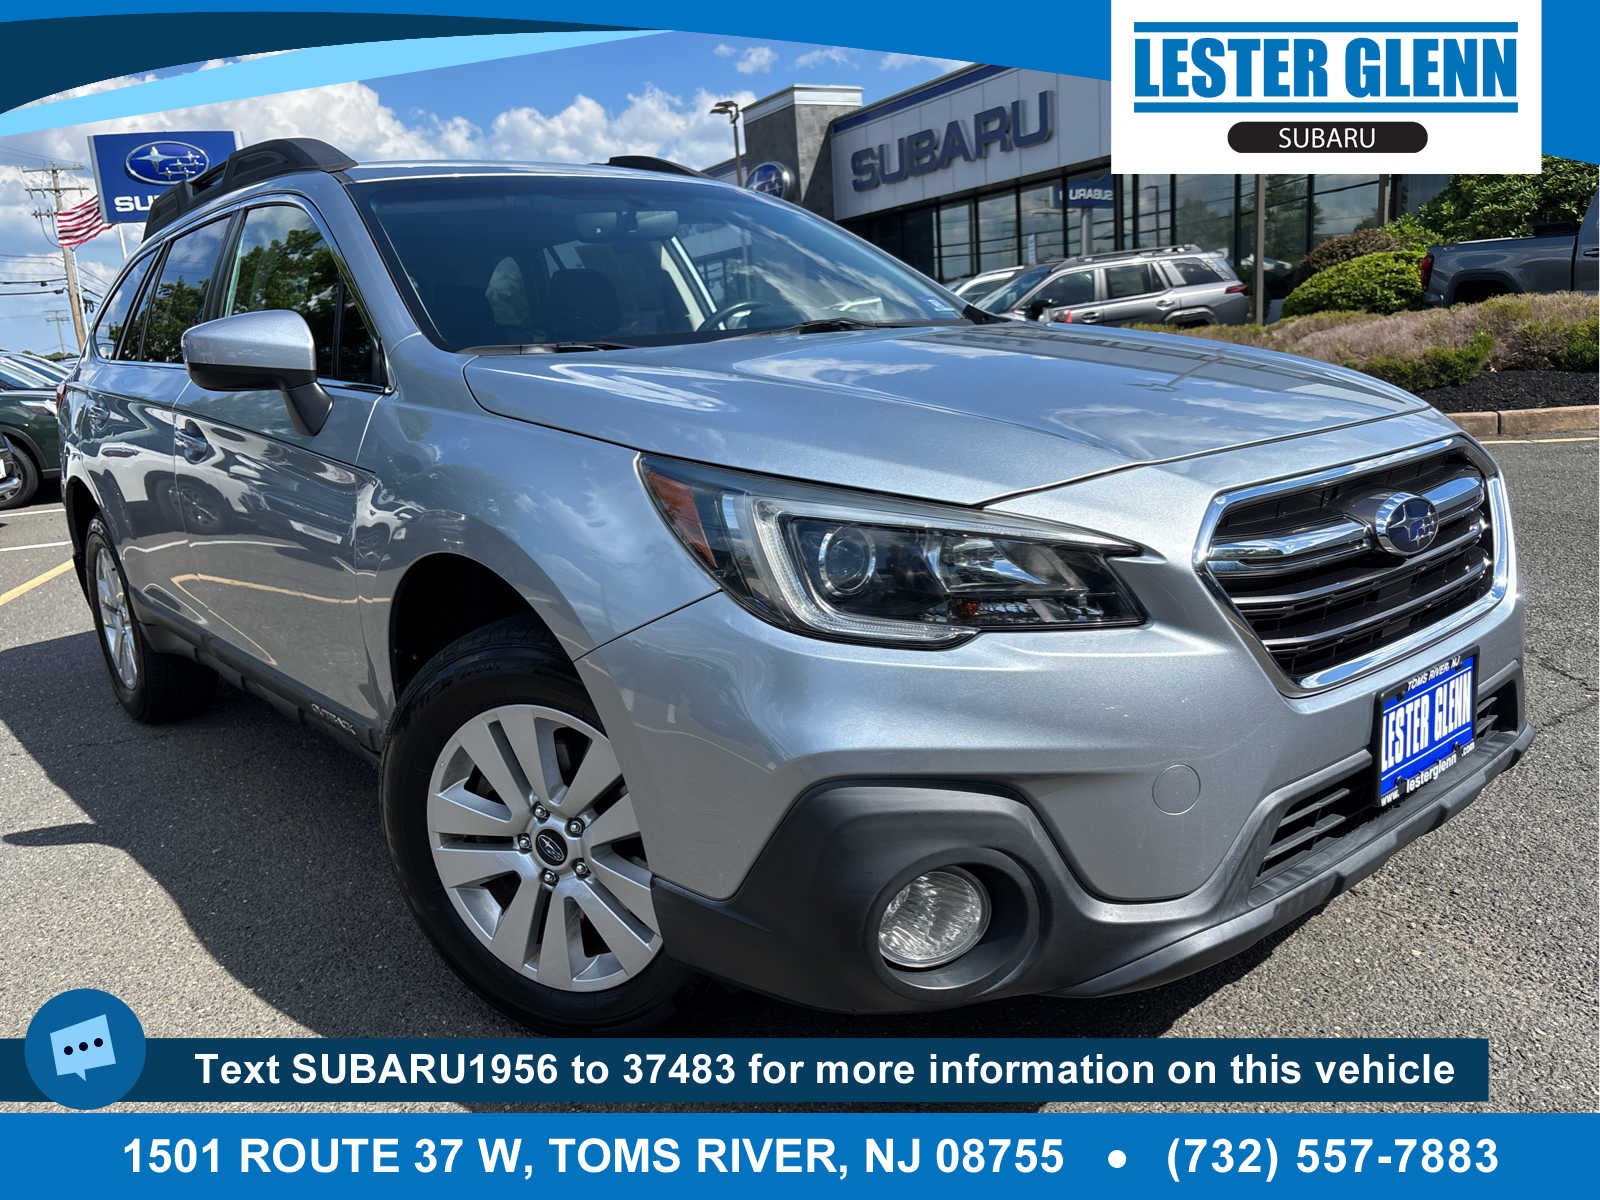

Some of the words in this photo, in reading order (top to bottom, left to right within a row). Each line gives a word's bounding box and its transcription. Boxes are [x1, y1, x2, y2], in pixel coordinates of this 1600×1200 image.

[851, 90, 1053, 193] SUBARU
[1407, 672, 1429, 691] TOMS
[1381, 694, 1430, 773] LESTER
[1434, 670, 1472, 742] GLENN
[1406, 754, 1457, 793] lesterglenn
